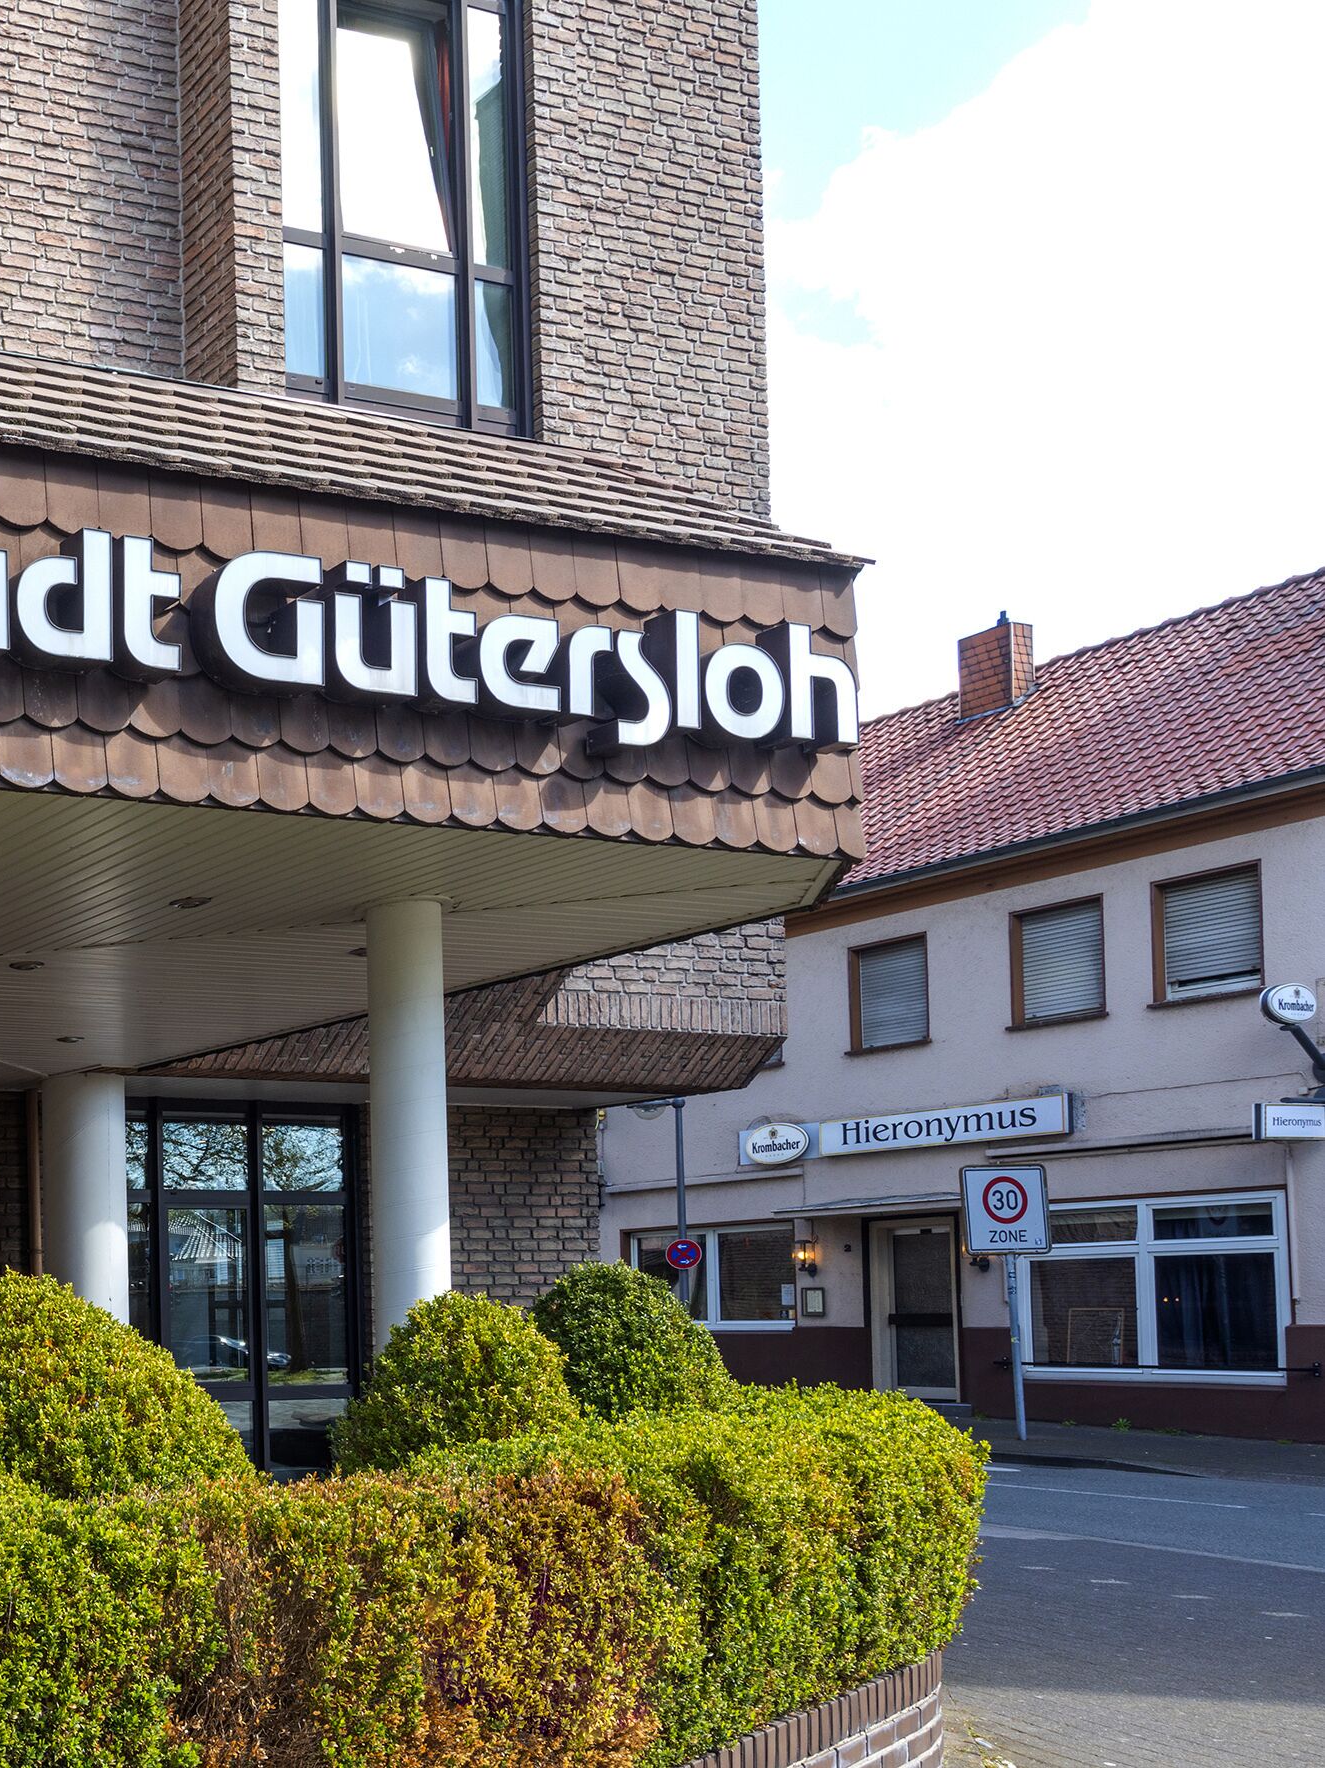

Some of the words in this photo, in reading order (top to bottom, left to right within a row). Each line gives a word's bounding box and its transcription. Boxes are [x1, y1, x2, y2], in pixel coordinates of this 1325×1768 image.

[209, 548, 862, 750] Gütersloh
[1277, 998, 1315, 1012] Krombacher
[840, 1106, 1037, 1147] Hieronymus
[1272, 1116, 1322, 1129] Hieronymus
[751, 1138, 801, 1154] Krombacher
[991, 1189, 1019, 1211] 30
[988, 1229, 1029, 1243] ZONE
[843, 1244, 852, 1252] 2
